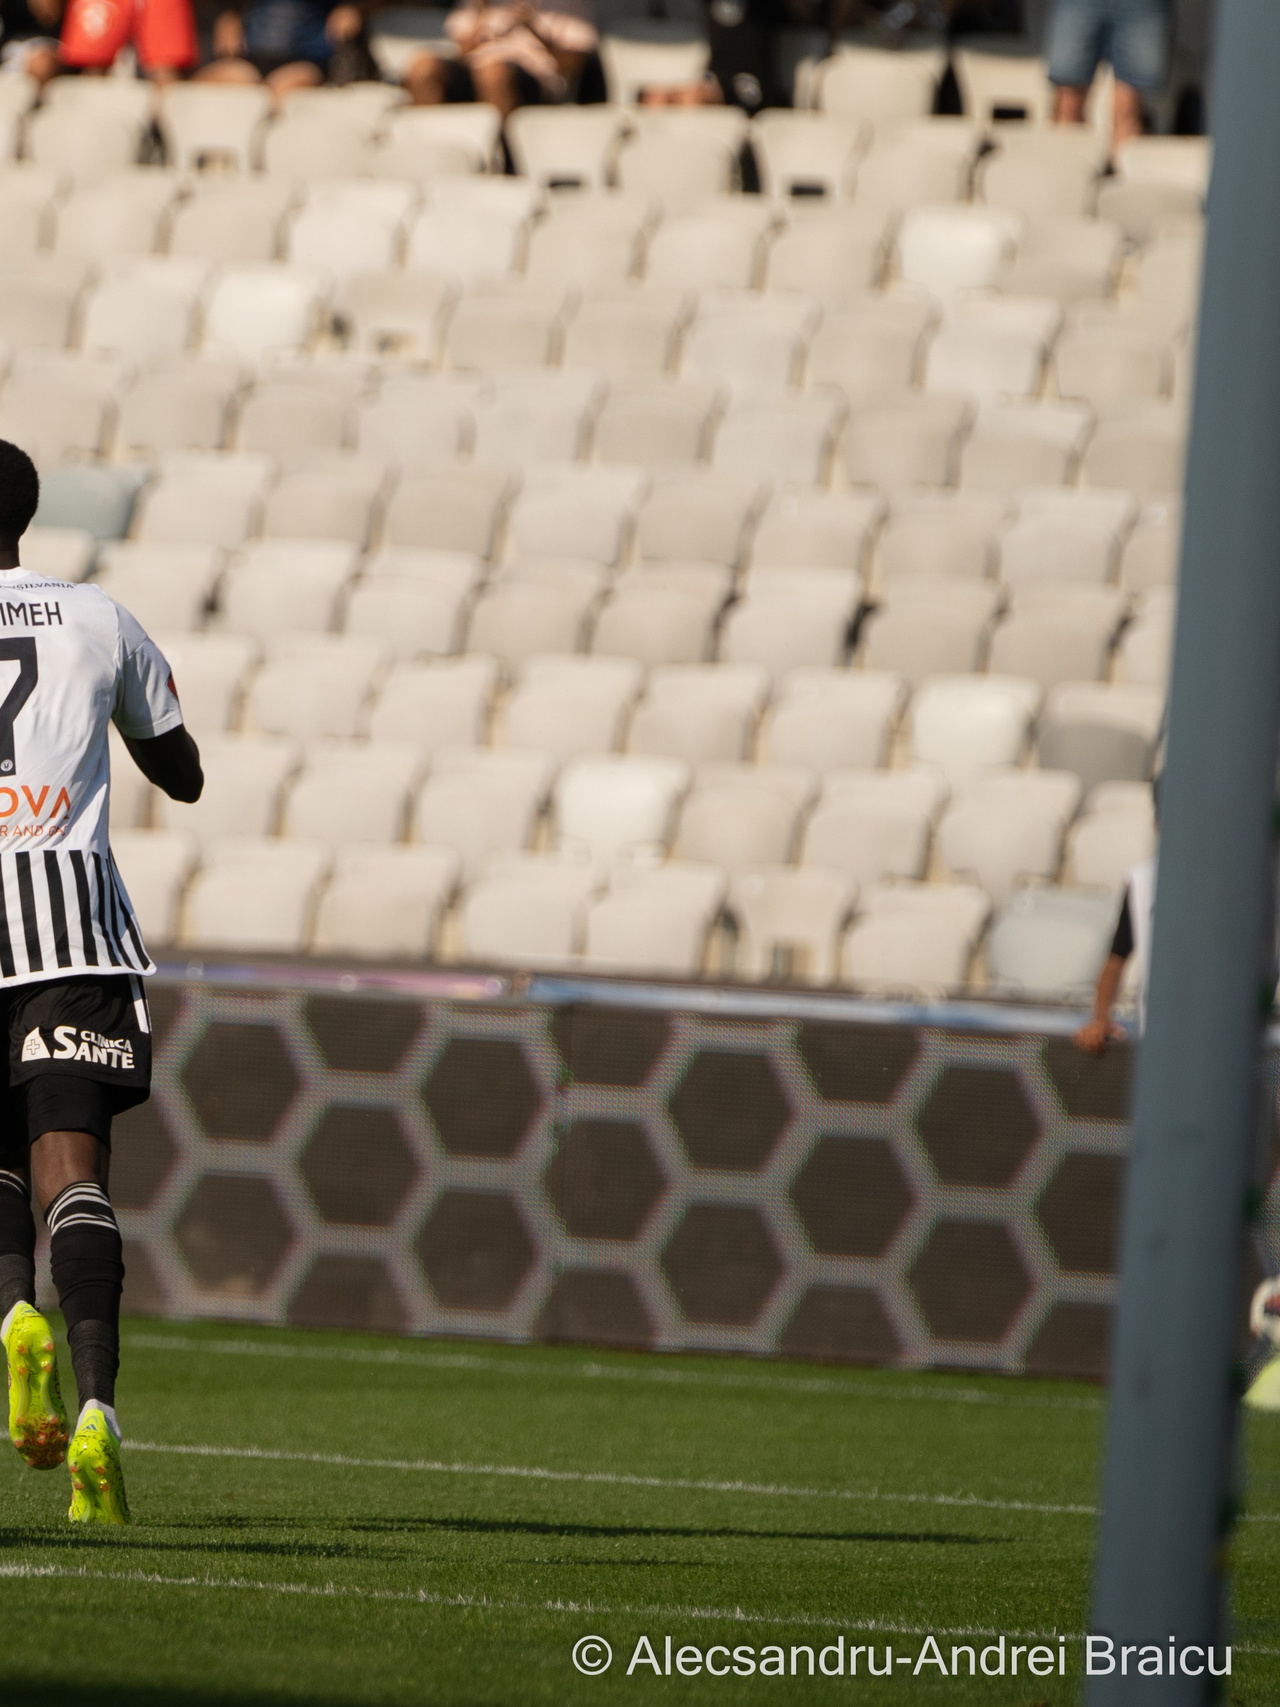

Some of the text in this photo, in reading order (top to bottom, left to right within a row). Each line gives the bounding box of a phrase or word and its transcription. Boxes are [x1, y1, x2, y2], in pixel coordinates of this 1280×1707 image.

[13, 825, 44, 837] AND
[53, 1025, 135, 1069] SANTE
[80, 1030, 133, 1052] CLINICA
